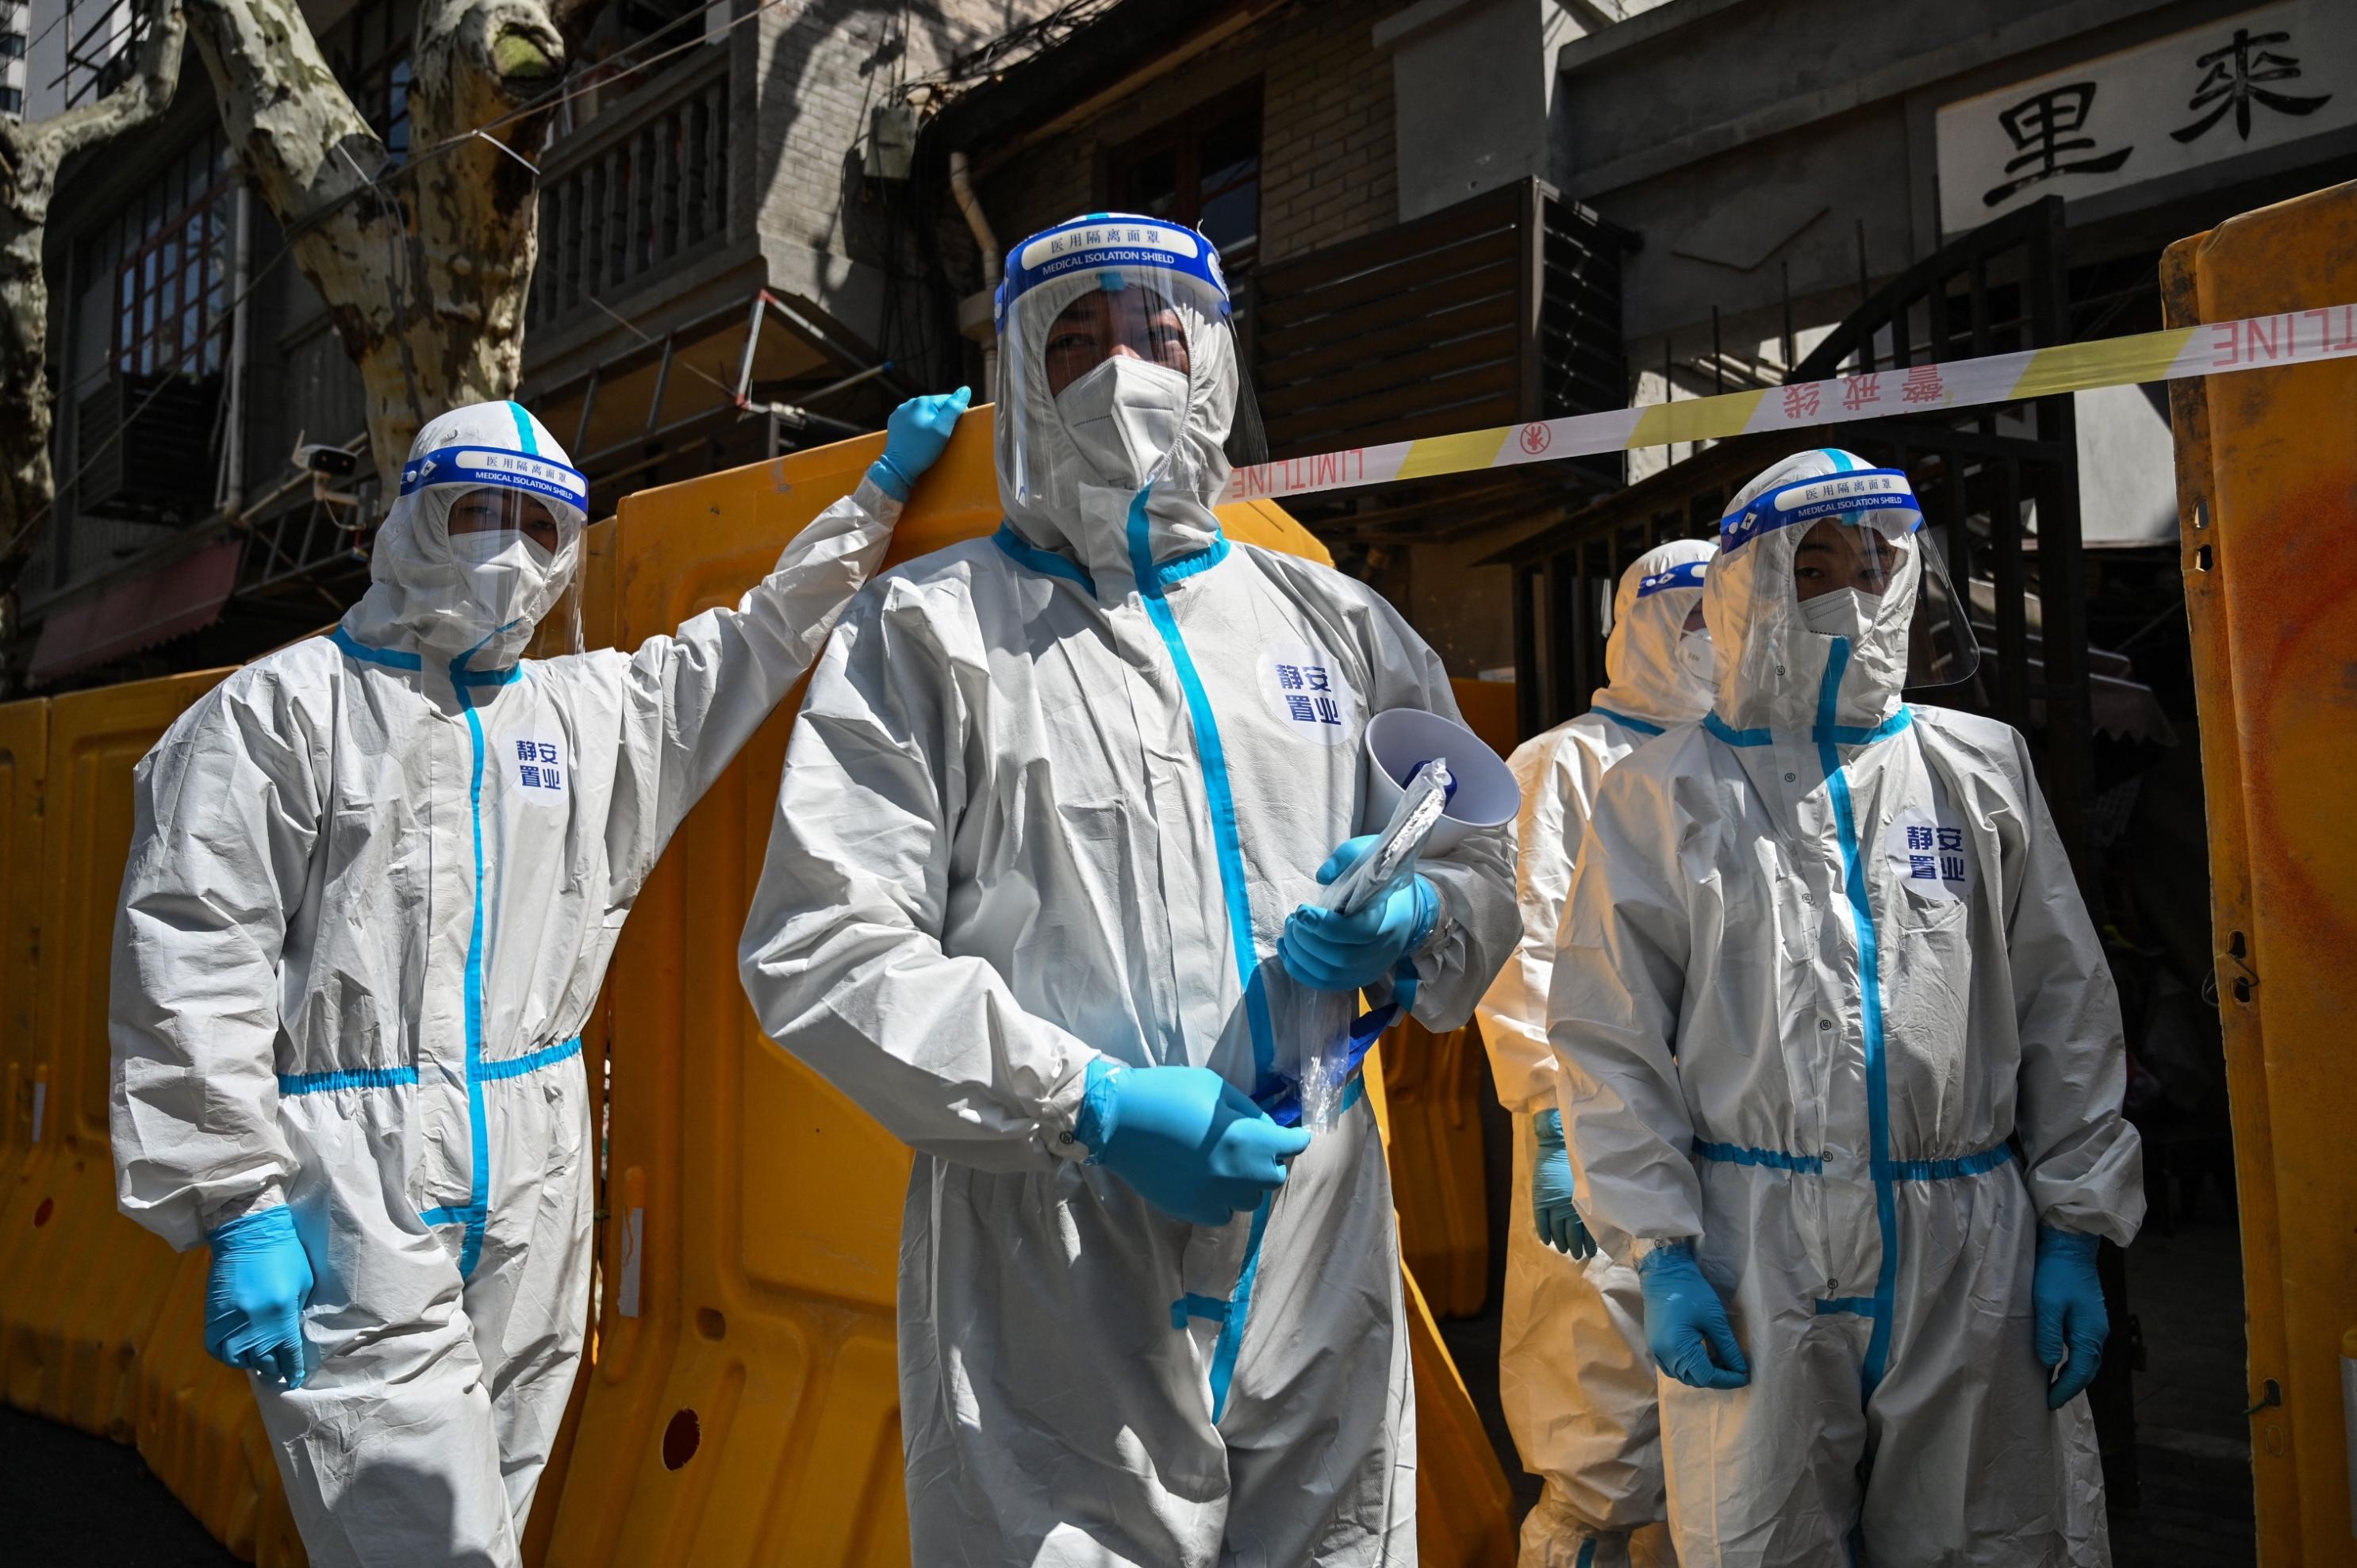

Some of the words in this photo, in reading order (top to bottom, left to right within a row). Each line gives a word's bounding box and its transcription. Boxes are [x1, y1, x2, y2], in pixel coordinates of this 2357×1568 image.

[1050, 228, 1161, 254] 医用隔离面罩
[1042, 258, 1084, 276] MEDICAL
[1084, 251, 1139, 264] ISOLATION
[1142, 253, 1174, 264] SHIELD
[1783, 363, 1942, 420] 警戒线
[486, 455, 567, 483] 医用隔离面罩
[476, 471, 512, 483] MEDICAL
[512, 477, 553, 493] ISOLATION
[552, 487, 573, 500] SHIELD
[1806, 477, 1892, 501] 医用隔离面罩
[1798, 503, 1837, 517] MEDICAL
[1837, 496, 1879, 510] ISOLATION
[1880, 495, 1902, 505] SHIELD
[1274, 664, 1331, 692] 静安
[1285, 695, 1342, 725] 置业
[516, 740, 559, 765] 静安
[520, 765, 561, 790] 置业
[1906, 826, 1964, 852] 静安
[1909, 855, 1965, 882] 置业
